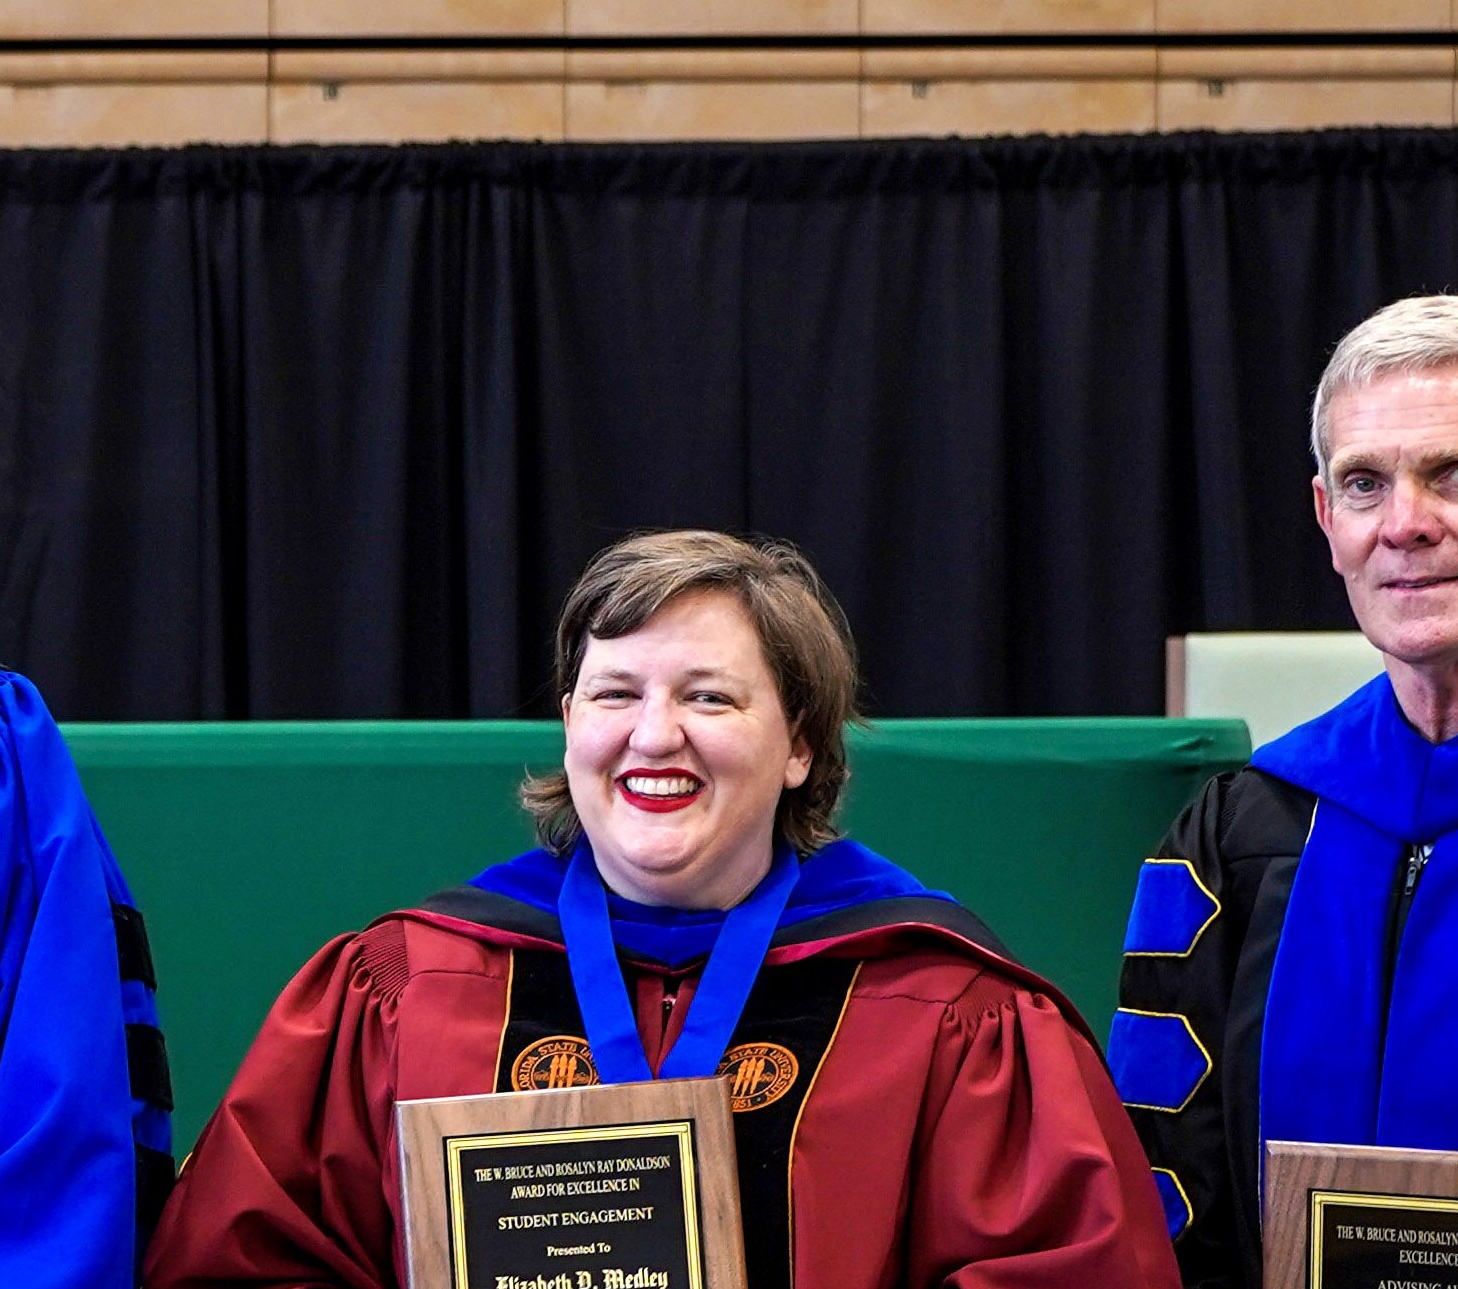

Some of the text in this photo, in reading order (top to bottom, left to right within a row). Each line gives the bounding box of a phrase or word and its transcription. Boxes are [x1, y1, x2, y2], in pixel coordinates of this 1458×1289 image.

[473, 1167, 493, 1182] THE
[504, 1164, 535, 1180] BRUCE
[534, 1163, 555, 1178] AND
[554, 1160, 596, 1176] ROSALYN
[596, 1159, 615, 1173] RAY
[615, 1155, 670, 1172] DONALDSON
[510, 1176, 640, 1200] AWARD FOR EXCELLENCE IN
[497, 1206, 654, 1230] STUDENT ENGAGEMENT
[1335, 1224, 1354, 1239] THE
[1366, 1226, 1396, 1242] BRUCE
[1396, 1228, 1417, 1244] AND
[1417, 1229, 1458, 1246] ROSALYN
[546, 1241, 611, 1257] Presented To
